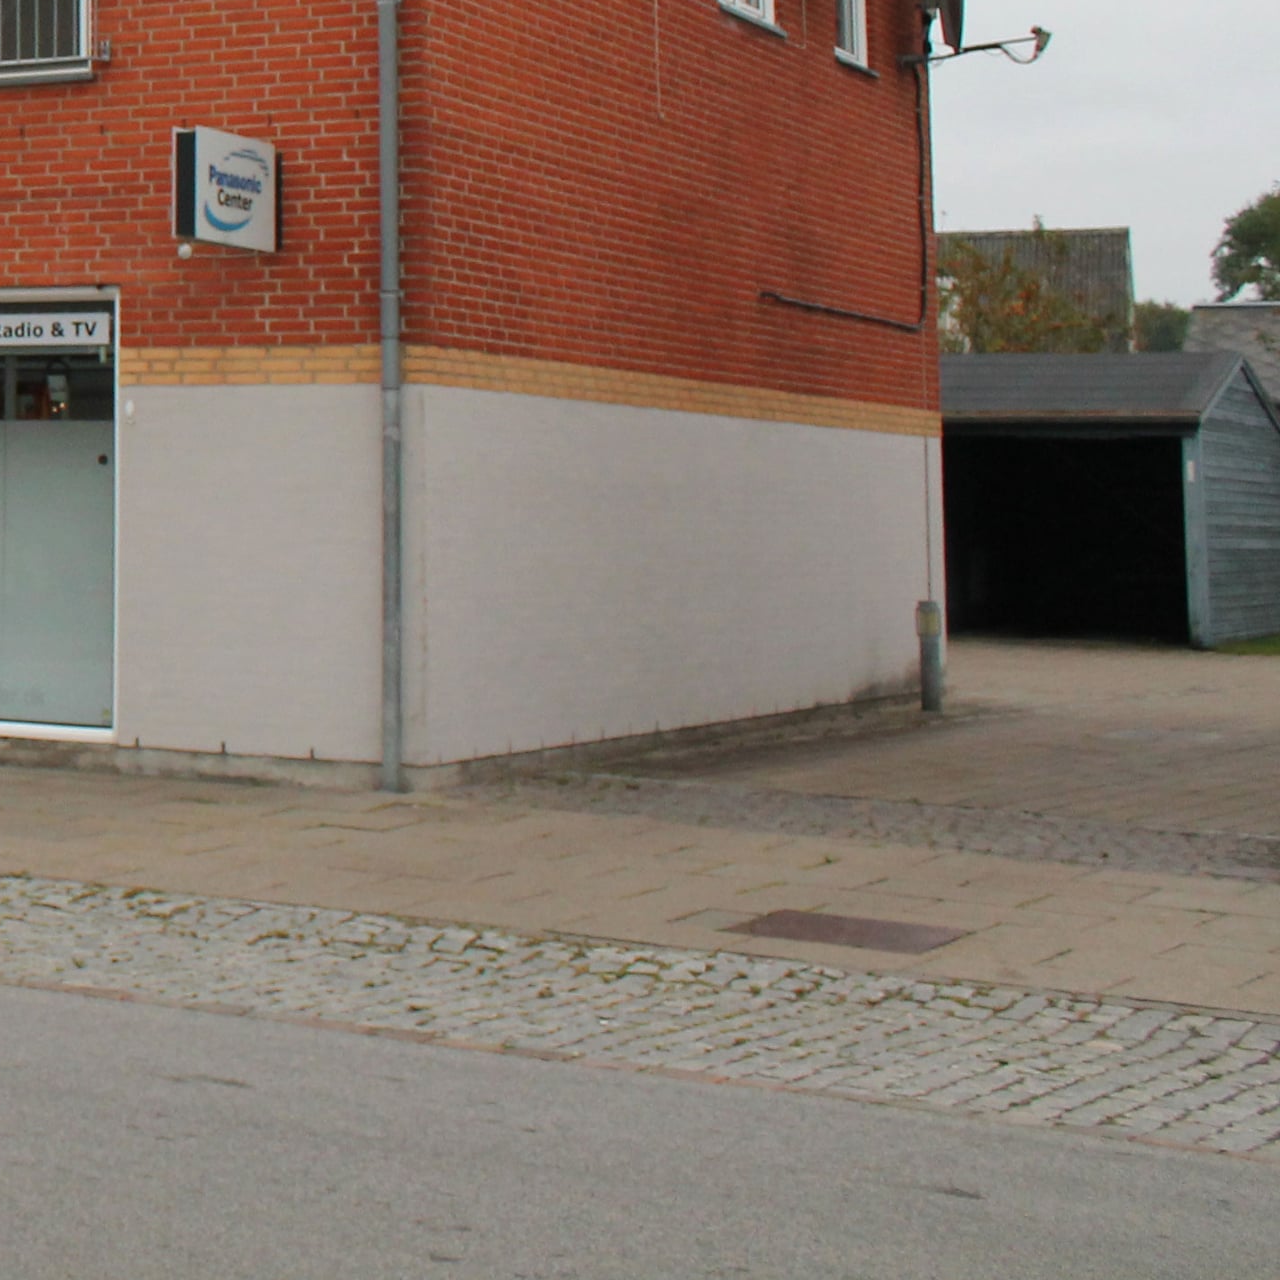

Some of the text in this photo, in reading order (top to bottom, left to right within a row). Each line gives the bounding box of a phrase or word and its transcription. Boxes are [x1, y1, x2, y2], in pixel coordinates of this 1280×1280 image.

[208, 164, 262, 194] Panasonic
[217, 188, 253, 211] Center
[50, 322, 65, 338] &
[72, 321, 97, 336] TV
